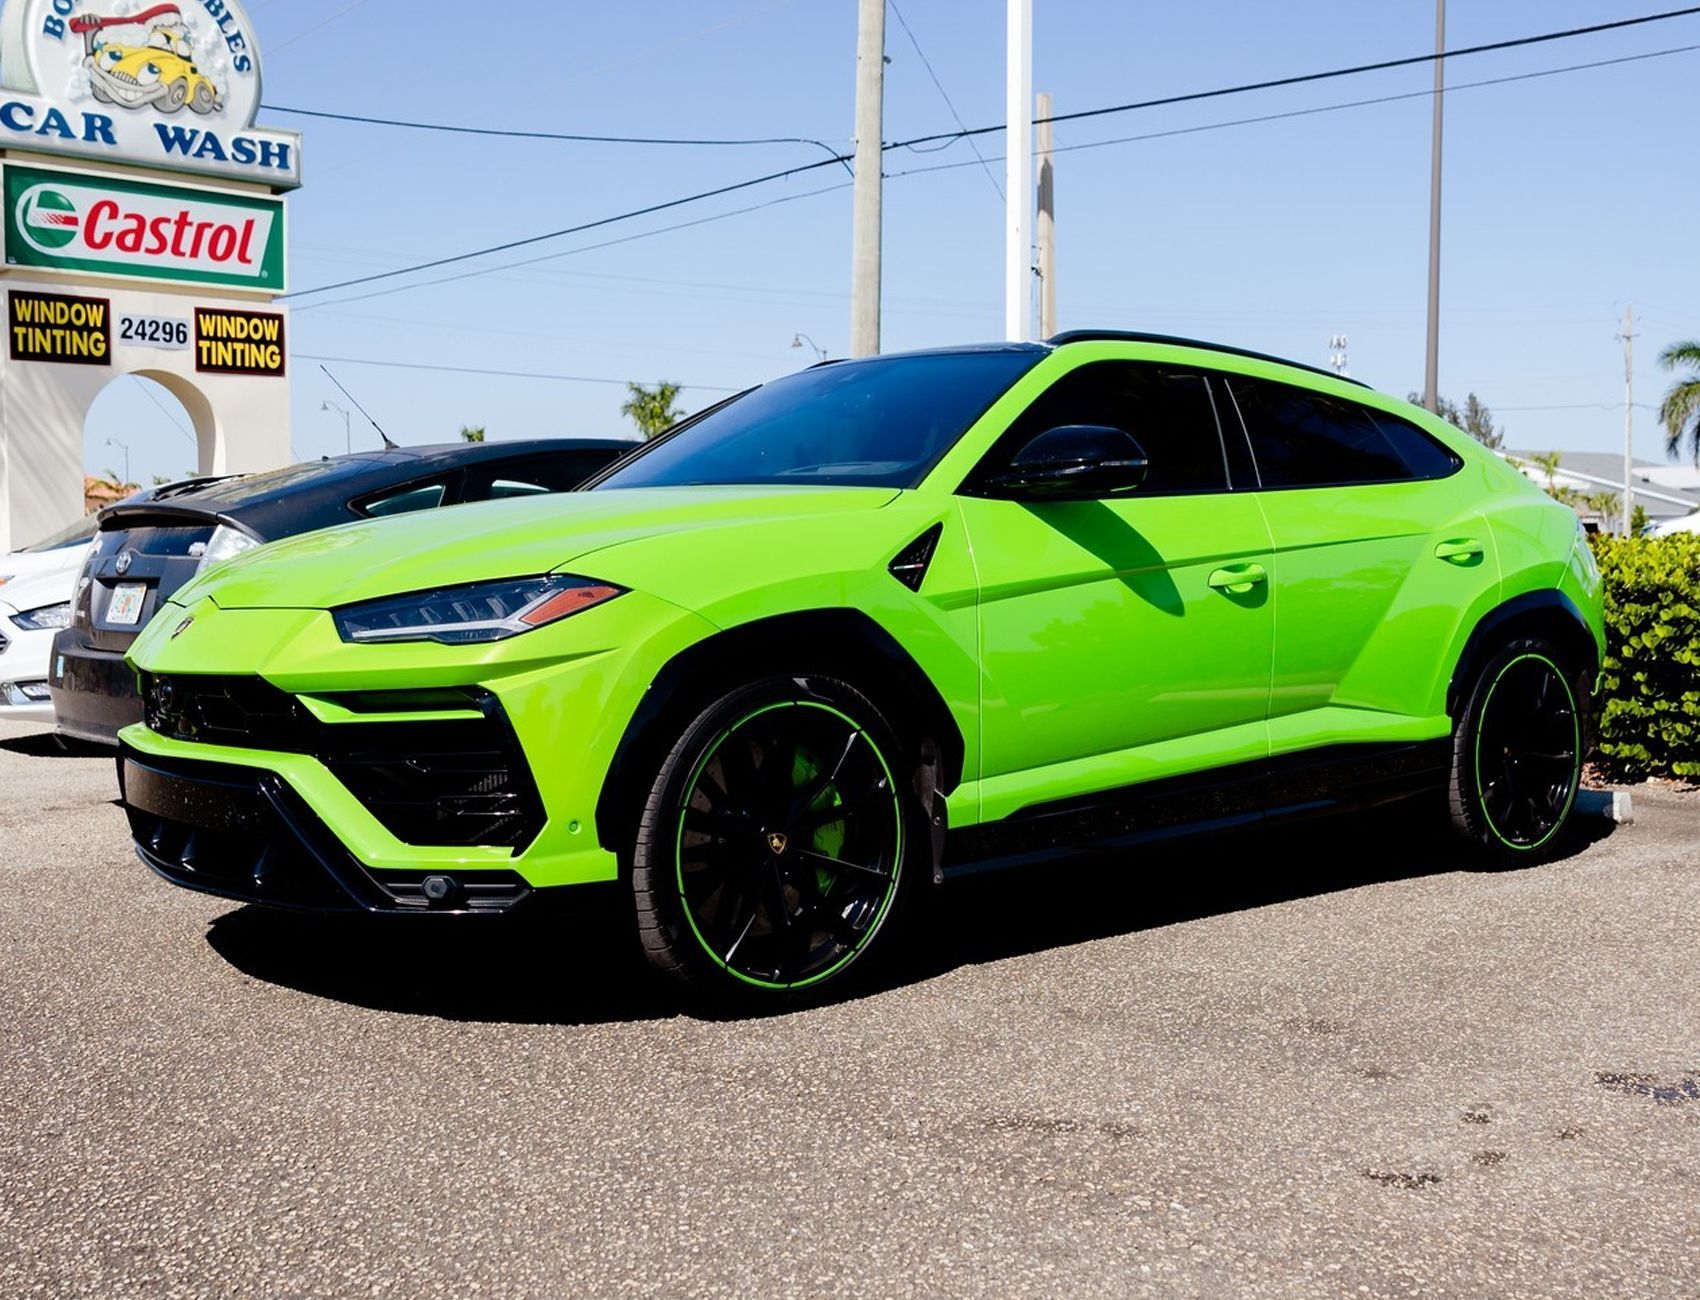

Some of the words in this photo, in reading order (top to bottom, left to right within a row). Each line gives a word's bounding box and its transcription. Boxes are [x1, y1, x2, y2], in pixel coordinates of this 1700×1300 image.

[43, 0, 75, 40] BO
[203, 0, 251, 72] BLES
[1, 101, 117, 145] CAR
[154, 123, 290, 169] WASH
[83, 200, 255, 264] Castrol
[14, 298, 104, 327] WINDOW
[199, 314, 279, 341] WINDOW
[14, 326, 106, 357] TINTING
[120, 317, 188, 344] 24296
[198, 341, 281, 369] TINTING
